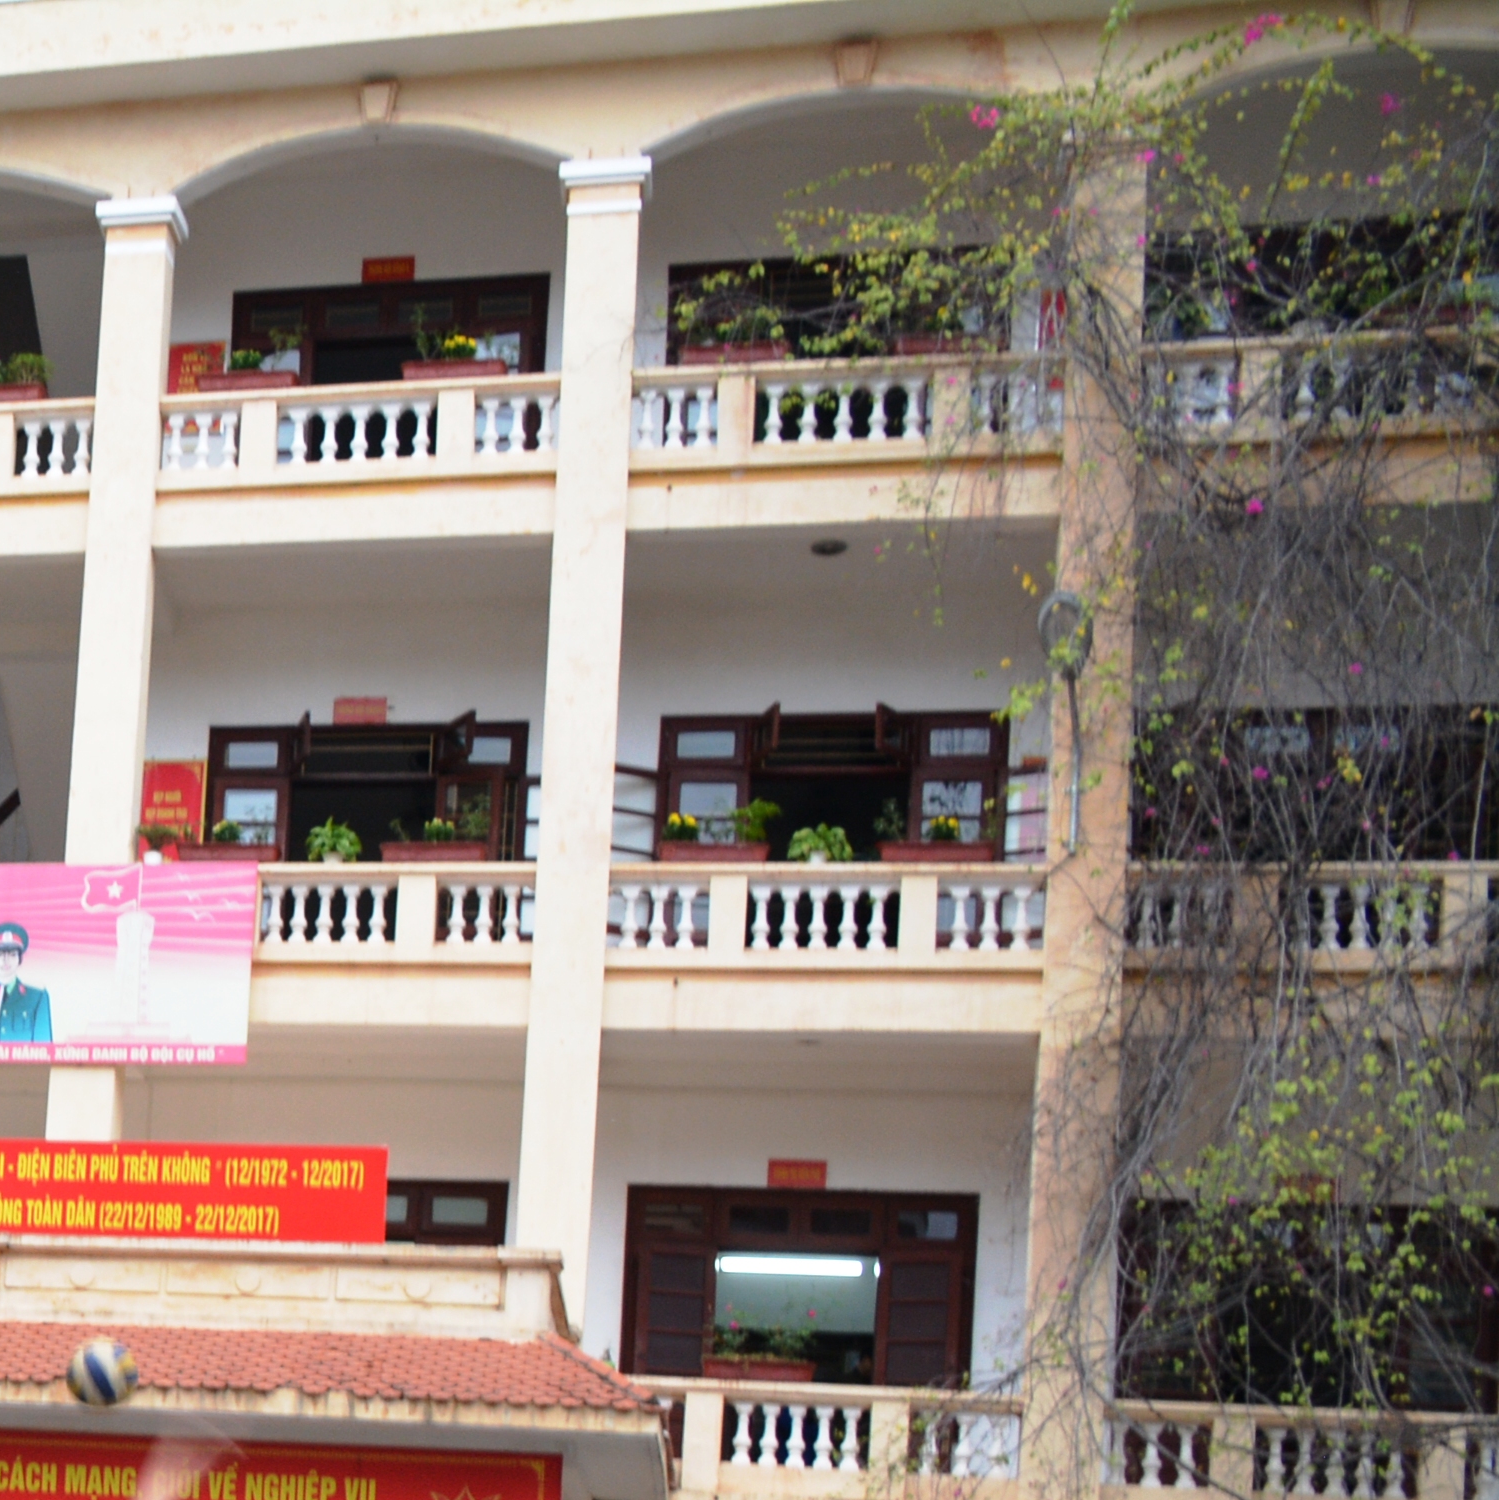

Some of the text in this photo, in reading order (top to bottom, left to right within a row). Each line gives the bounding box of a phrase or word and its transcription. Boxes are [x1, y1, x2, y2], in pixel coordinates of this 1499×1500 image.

[17, 1147, 50, 1187] ĐIỆN
[53, 1147, 86, 1182] BIÊN
[90, 1143, 119, 1184] PHỦ
[122, 1150, 158, 1184] TRÊN
[162, 1150, 211, 1185] KHÔNG
[26, 1194, 62, 1226] TOÀN
[66, 1195, 96, 1228] DÂN
